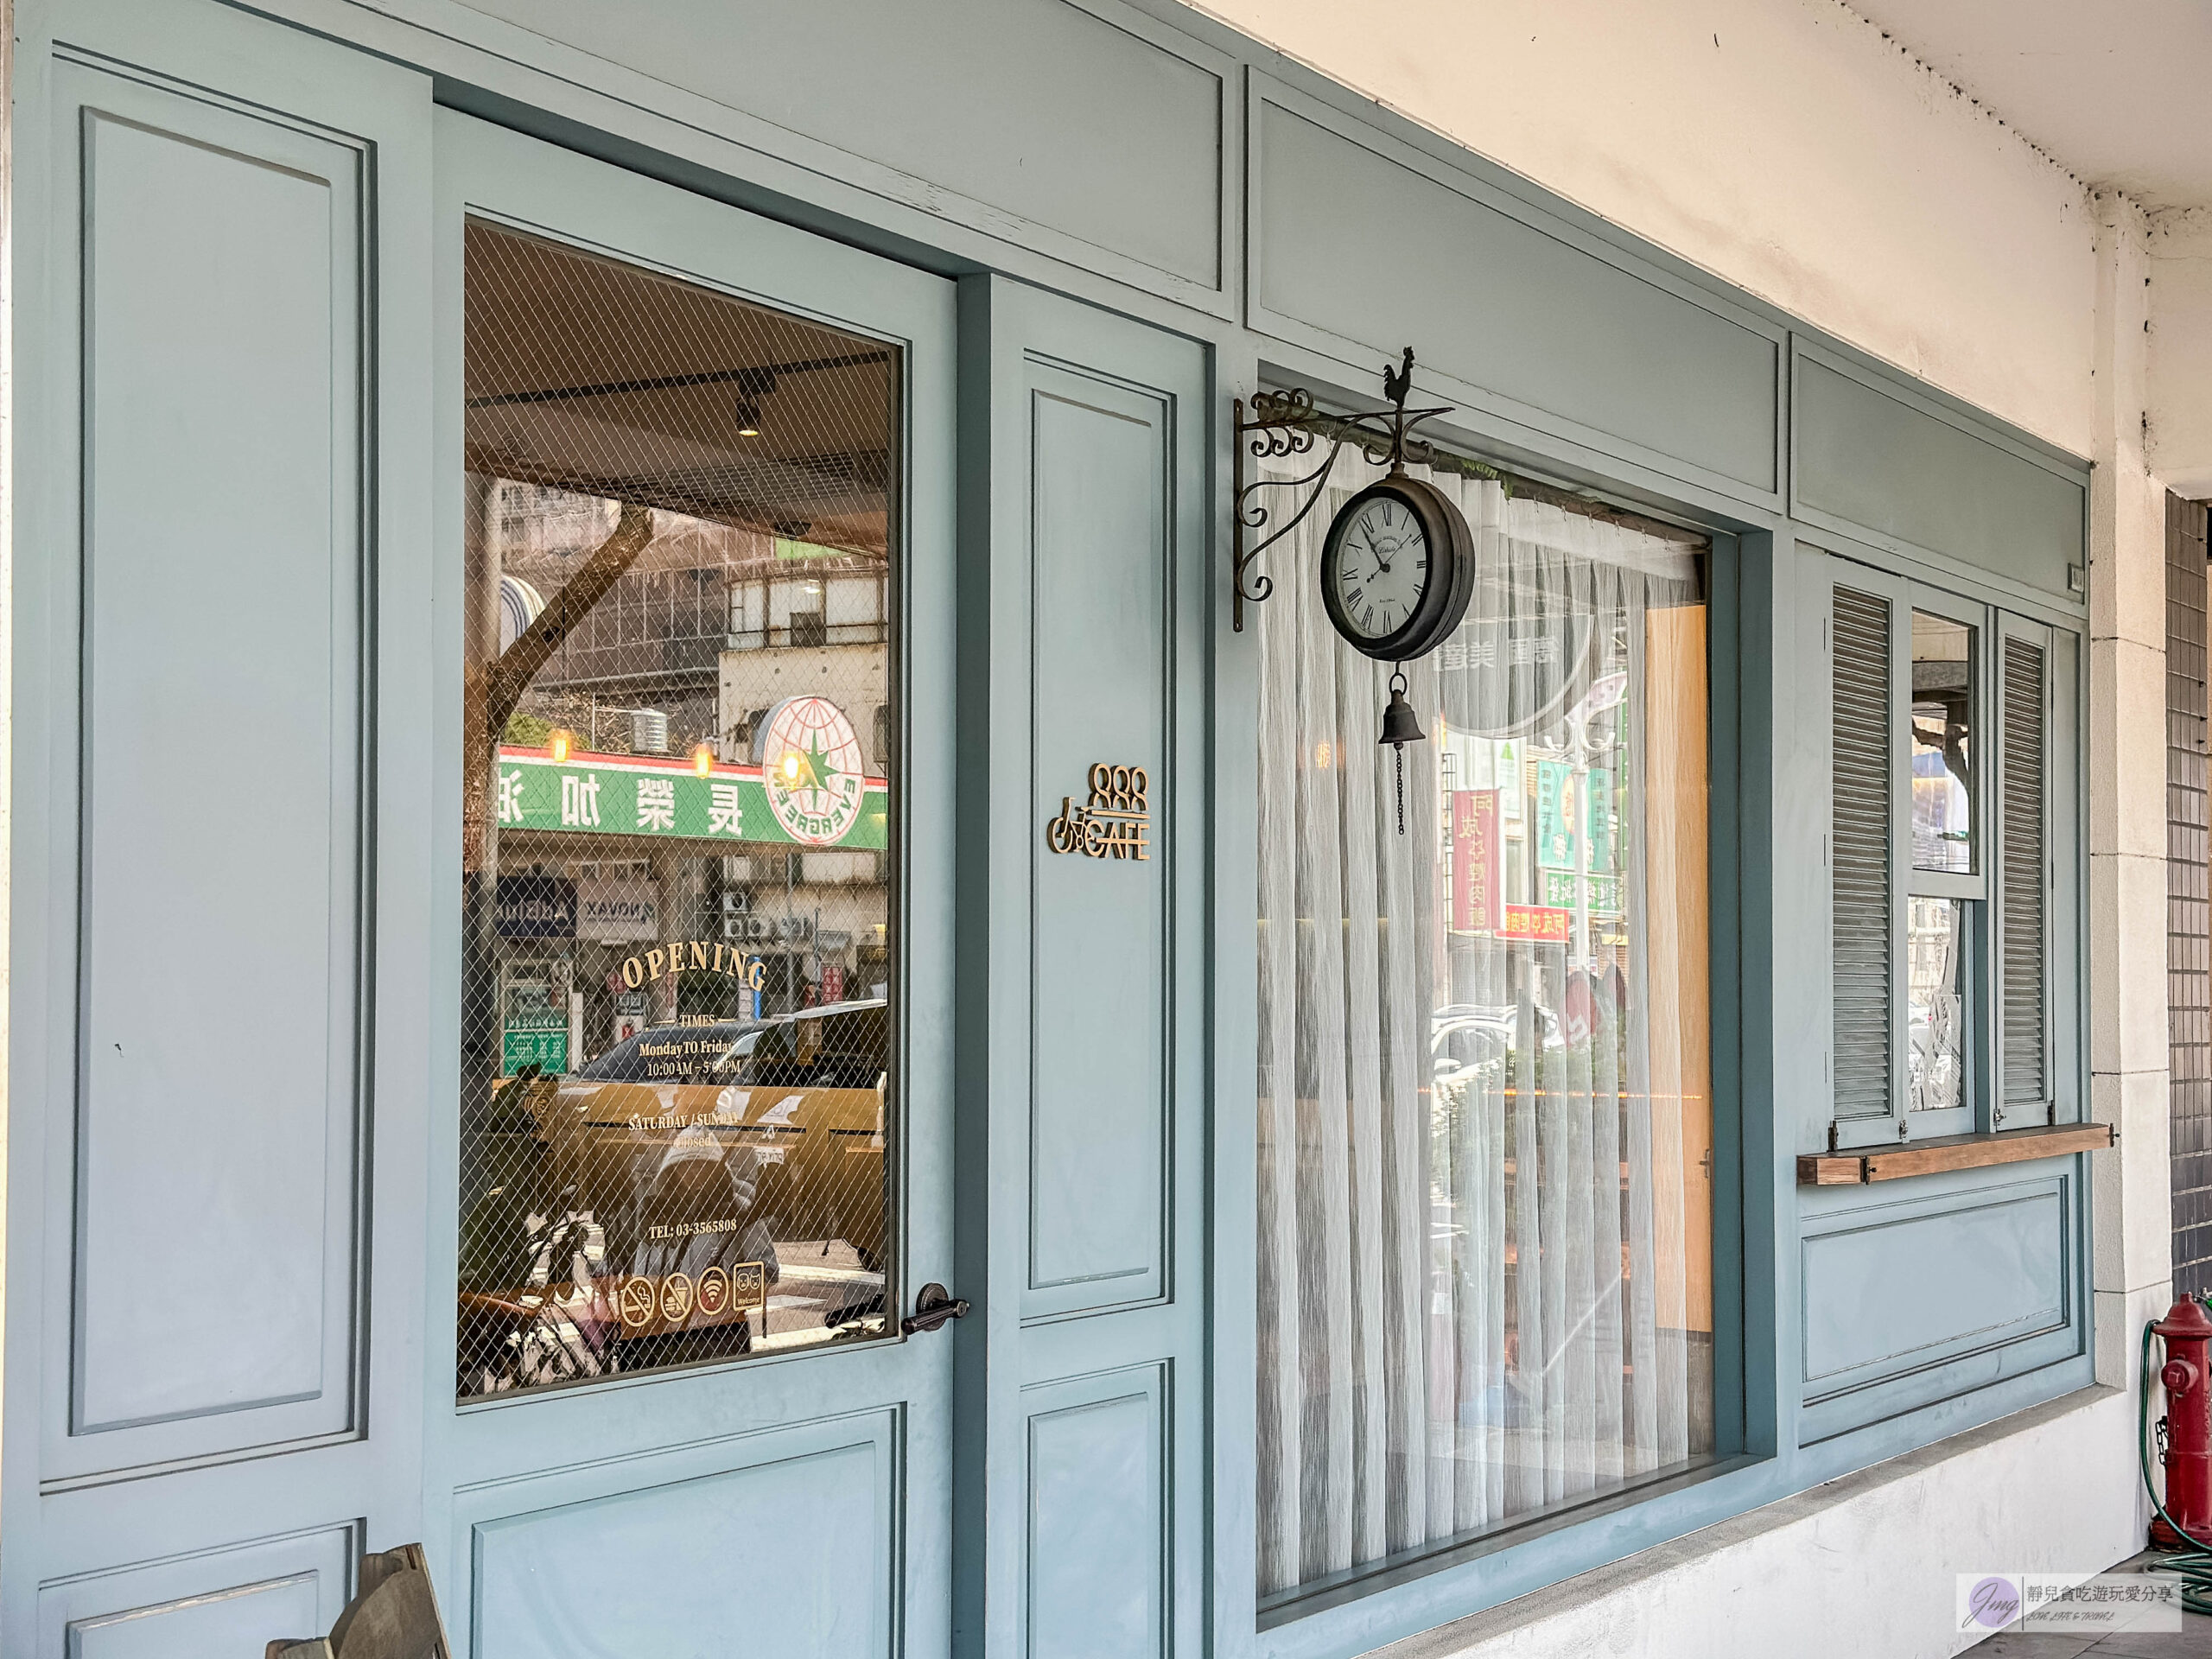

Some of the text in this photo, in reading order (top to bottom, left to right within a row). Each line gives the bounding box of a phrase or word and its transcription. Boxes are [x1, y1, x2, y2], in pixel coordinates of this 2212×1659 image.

[1089, 763, 1149, 810] 888
[1084, 819, 1150, 860] CAFE
[622, 941, 767, 991] OPENING
[679, 1014, 715, 1027] TIMES
[639, 1041, 683, 1058] Monday
[628, 1115, 688, 1131] SATURDAY
[697, 1111, 739, 1127] SUNDAY
[649, 1219, 737, 1239] TEL: 03-3565808
